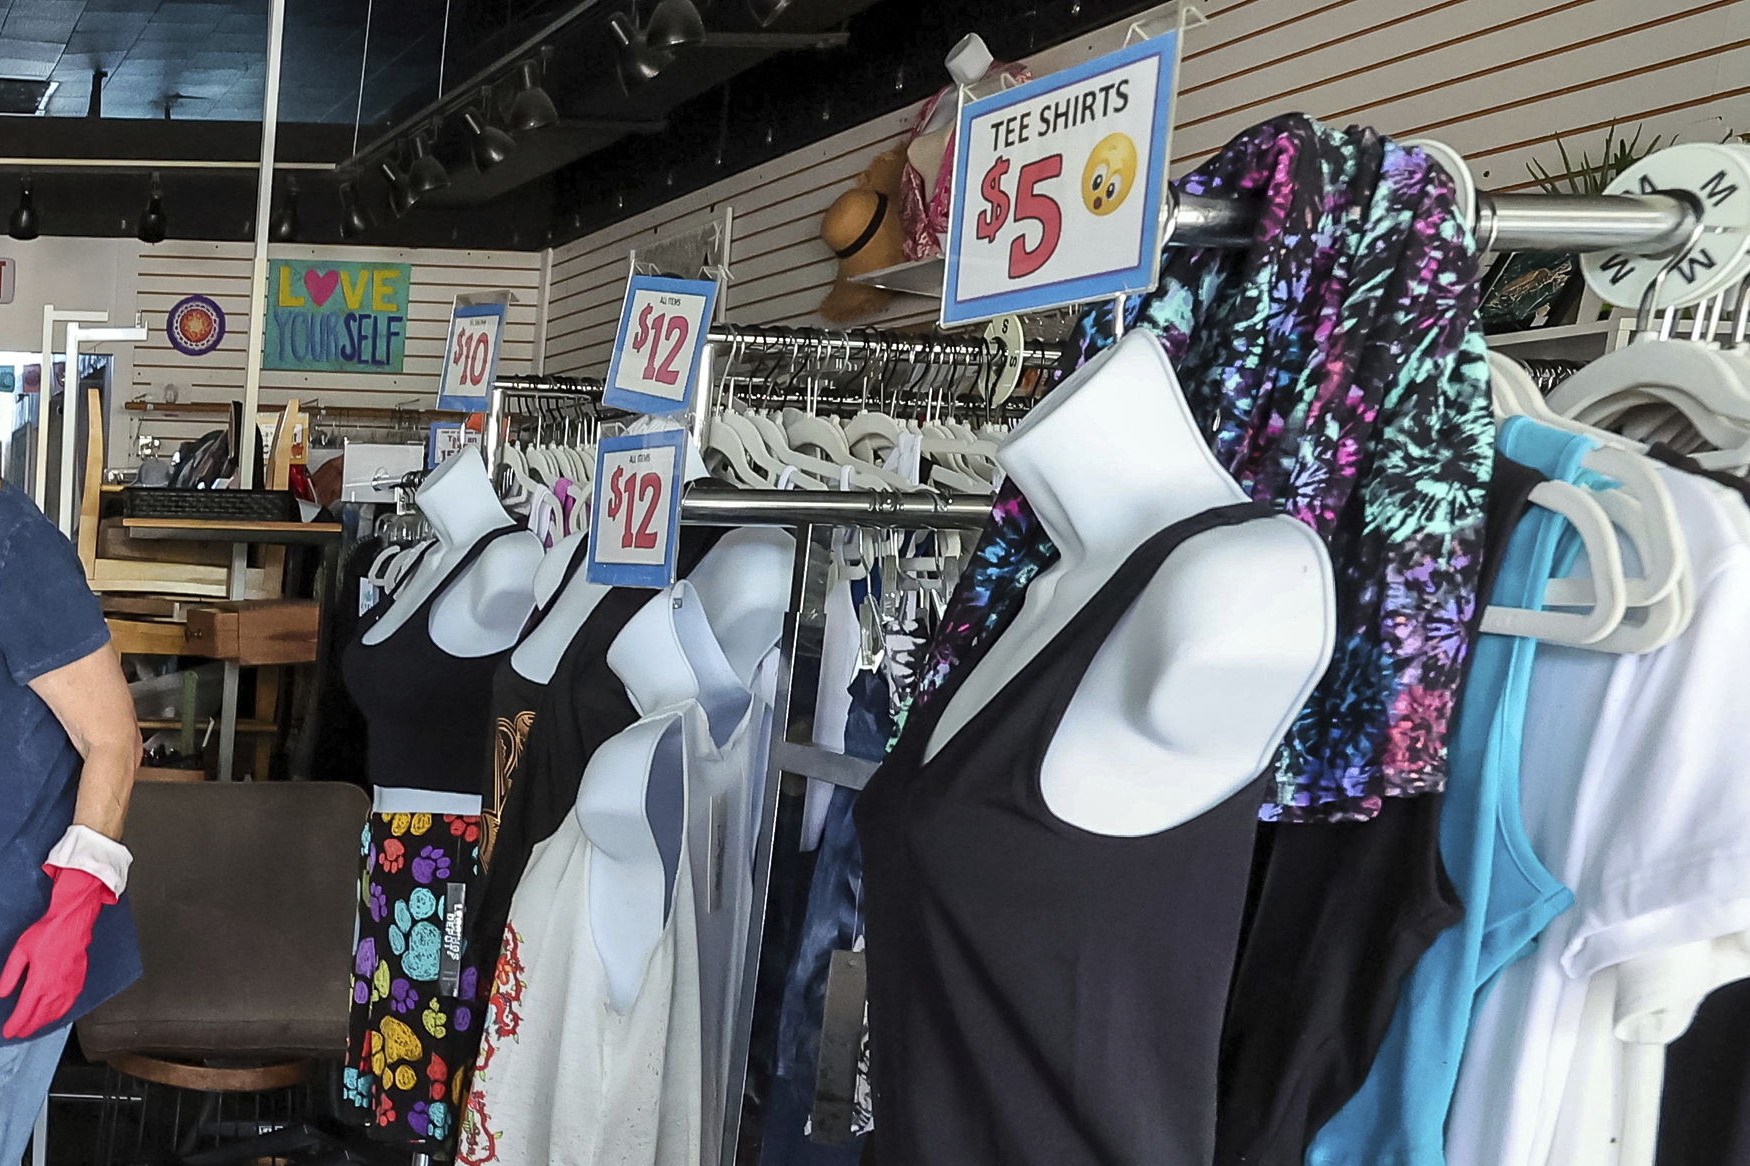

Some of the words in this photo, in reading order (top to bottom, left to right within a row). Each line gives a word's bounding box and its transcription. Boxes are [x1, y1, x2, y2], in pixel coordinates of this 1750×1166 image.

[990, 110, 1032, 152] TEE
[1037, 78, 1130, 138] SHIRTS
[976, 153, 1063, 280] $5
[273, 310, 404, 366] YOURSELF
[453, 326, 489, 387] $10
[632, 302, 689, 386] $12
[1001, 318, 1009, 334] S
[608, 464, 662, 550] $12
